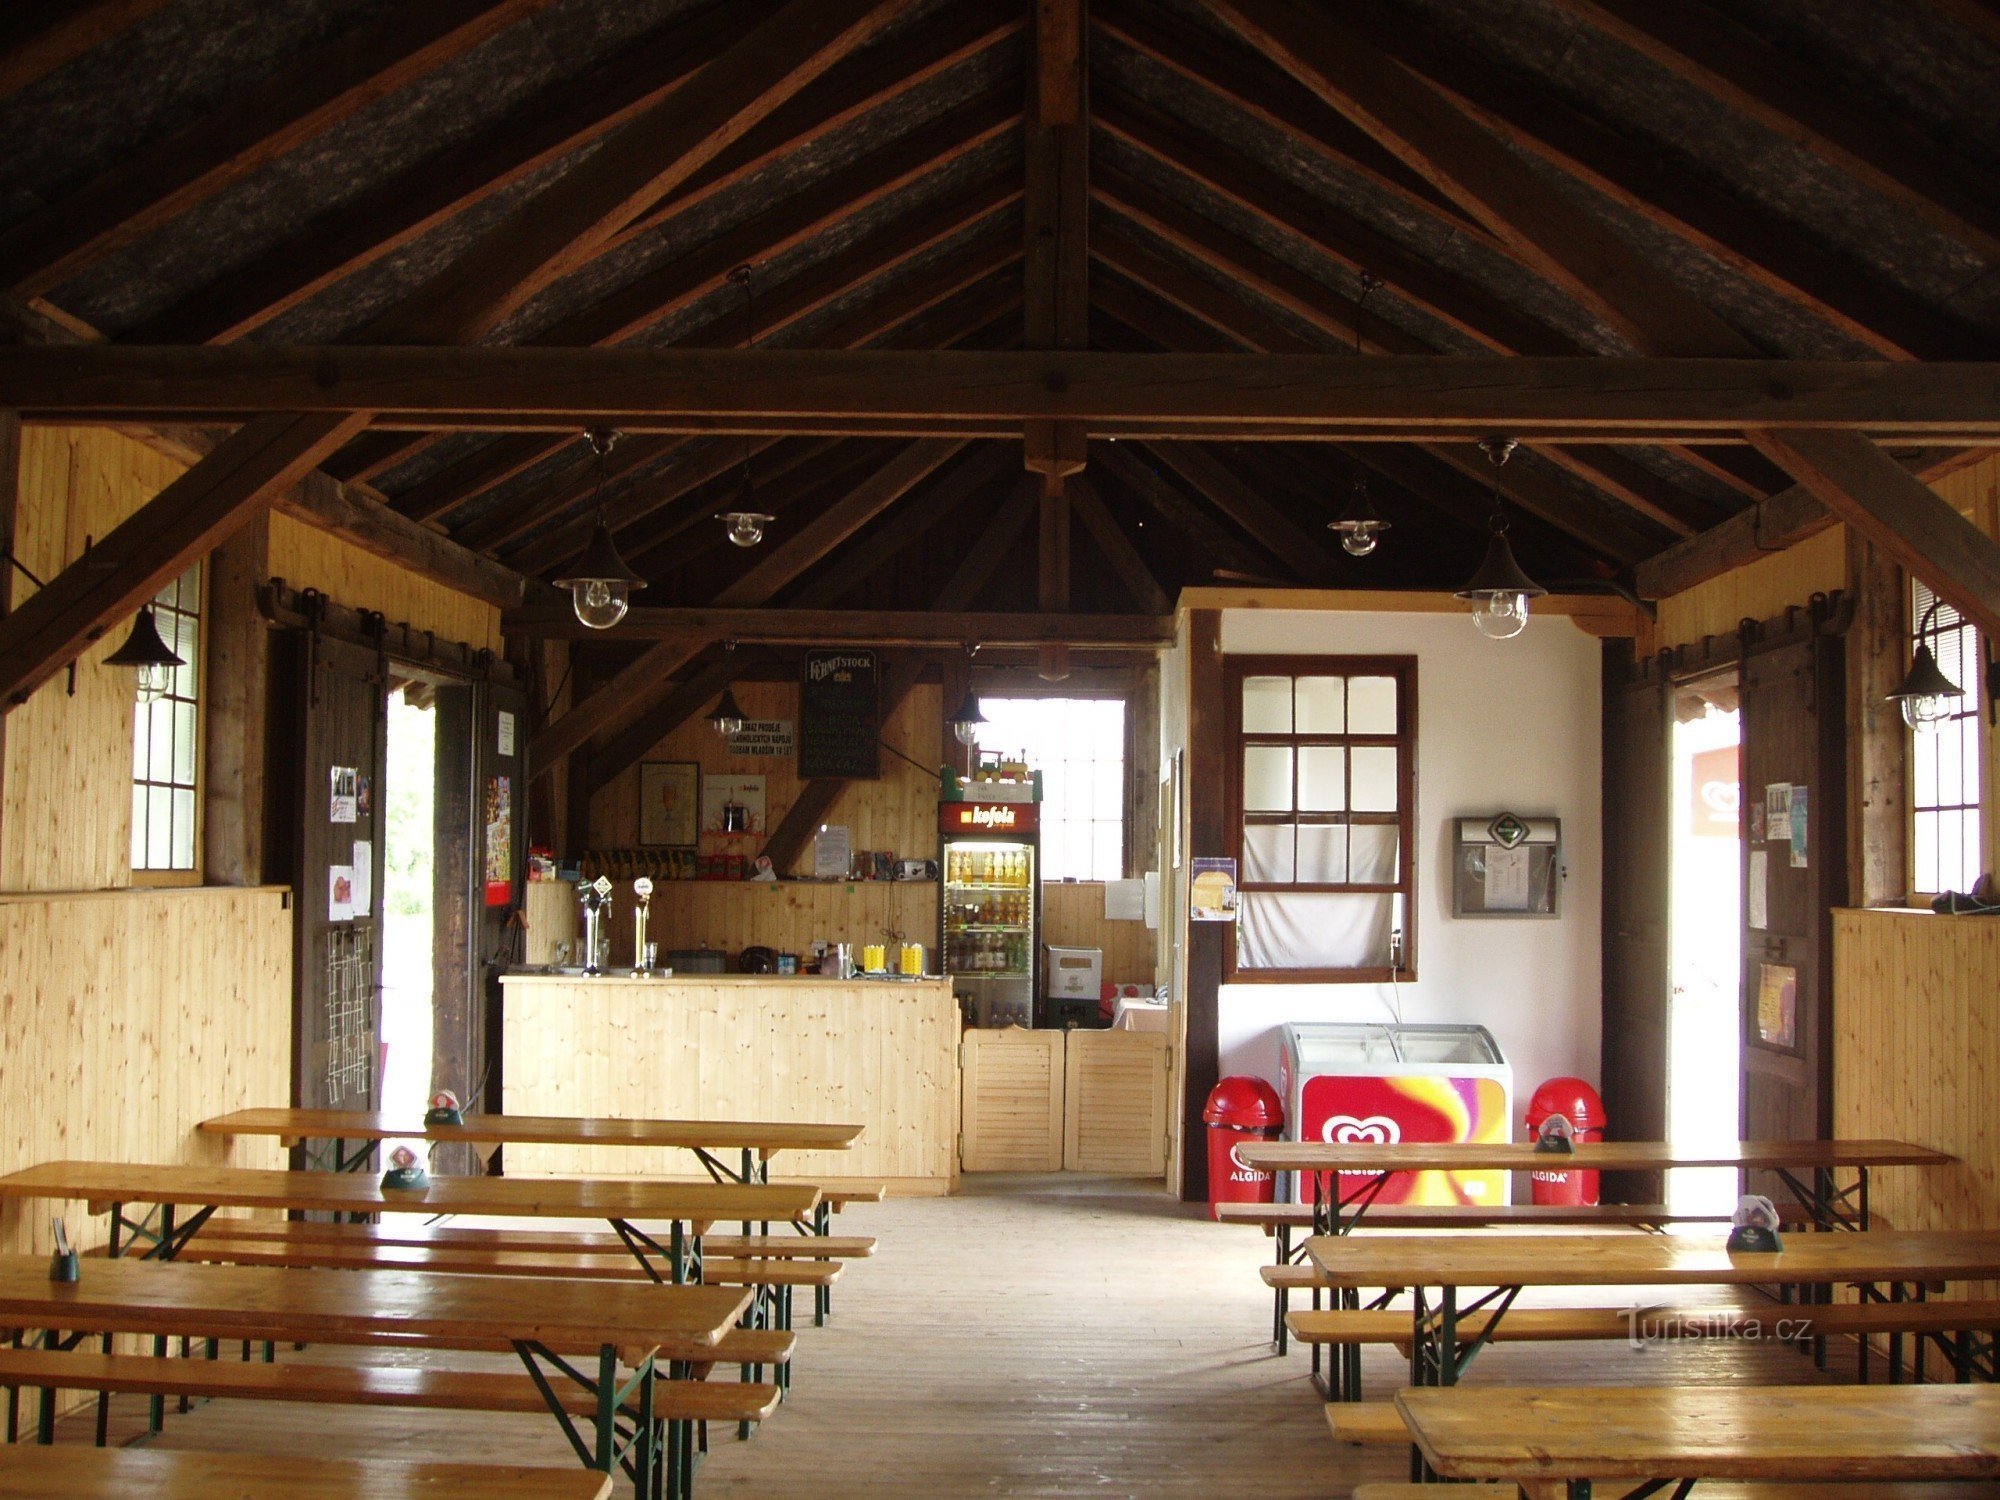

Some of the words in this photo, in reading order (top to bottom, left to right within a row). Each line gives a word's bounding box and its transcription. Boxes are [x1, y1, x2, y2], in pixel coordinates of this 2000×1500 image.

[841, 658, 871, 668] STOCK
[972, 806, 1015, 828] kofola
[1230, 1171, 1271, 1182] ALGIDA
